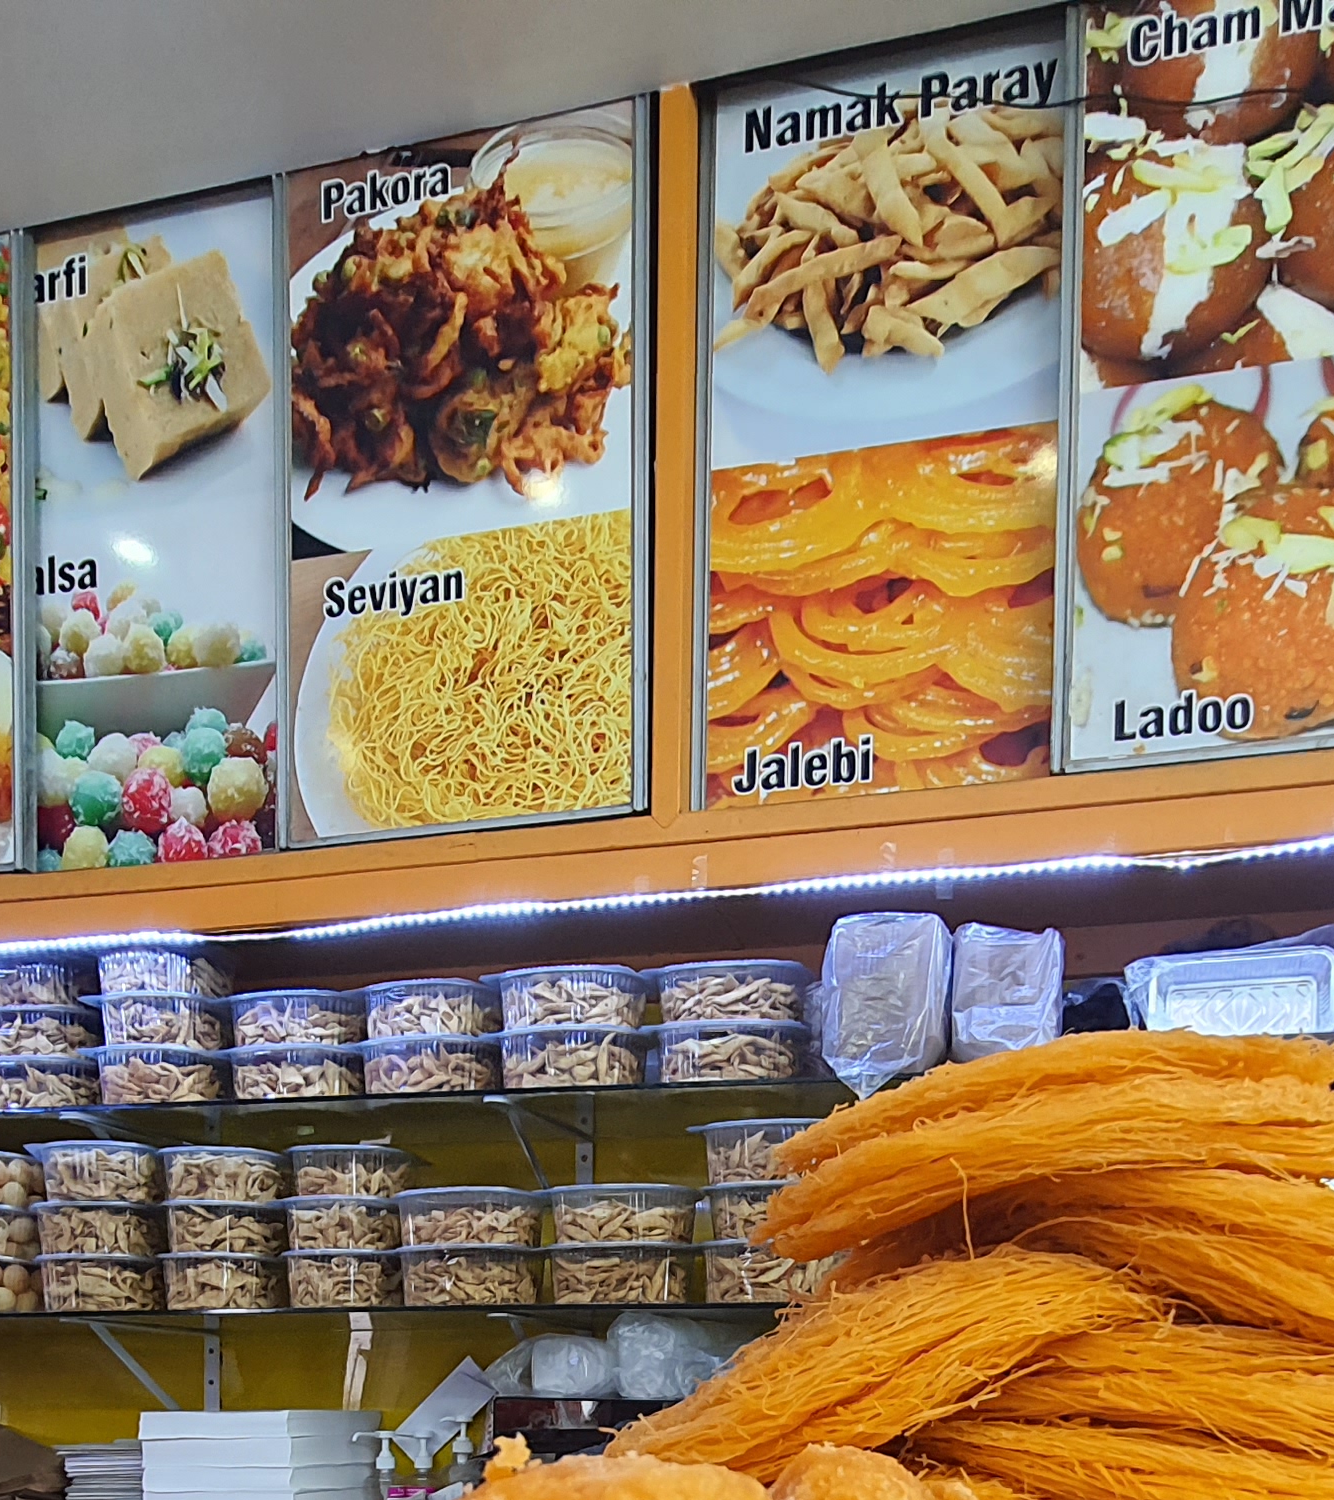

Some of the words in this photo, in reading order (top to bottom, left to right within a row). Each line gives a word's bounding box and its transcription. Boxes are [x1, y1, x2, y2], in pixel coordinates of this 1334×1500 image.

[1129, 5, 1261, 63] Cham
[744, 81, 904, 153] Namak
[920, 58, 1058, 118] Paray
[322, 164, 450, 221] Pakora
[324, 569, 464, 618] Seviyan
[1113, 691, 1252, 742] Ladoo
[732, 735, 872, 794] Jalebi
